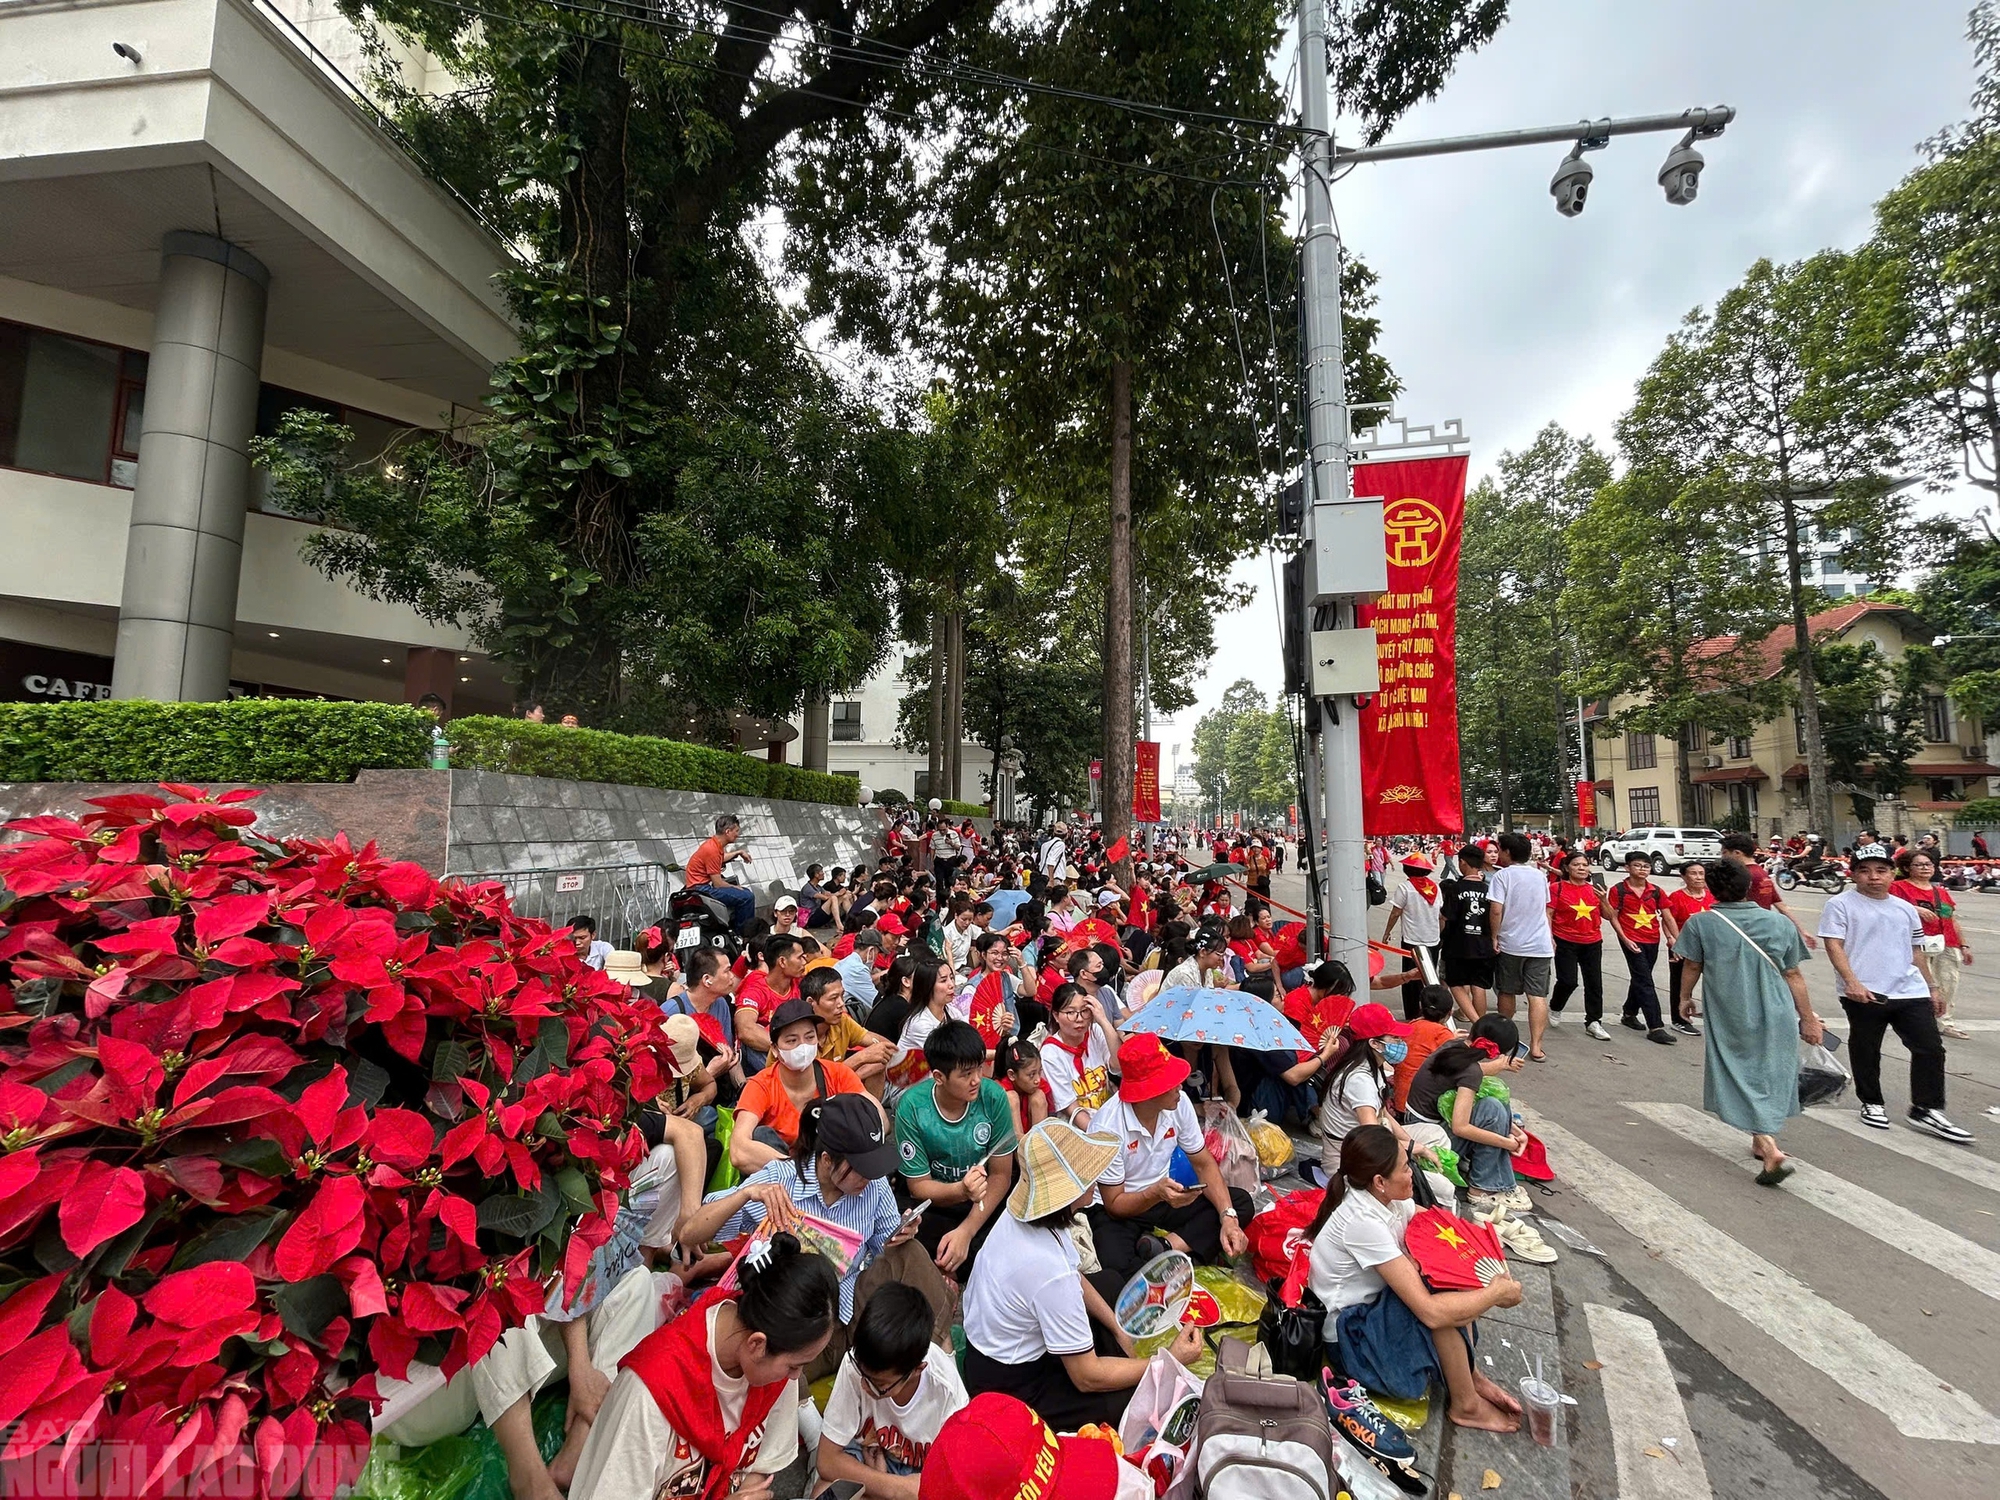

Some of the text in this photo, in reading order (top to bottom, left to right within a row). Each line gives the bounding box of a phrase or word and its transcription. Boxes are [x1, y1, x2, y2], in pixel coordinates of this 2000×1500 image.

[1396, 594, 1411, 609] HUY
[1390, 619, 1411, 637] MẠNG
[1421, 610, 1439, 630] TÁM,
[1414, 637, 1434, 657] DỰNG
[1415, 658, 1434, 678] CHẮC
[562, 881, 578, 889] STOP
[1338, 1412, 1376, 1448] HOKA
[1034, 1445, 1055, 1484] YÊU
